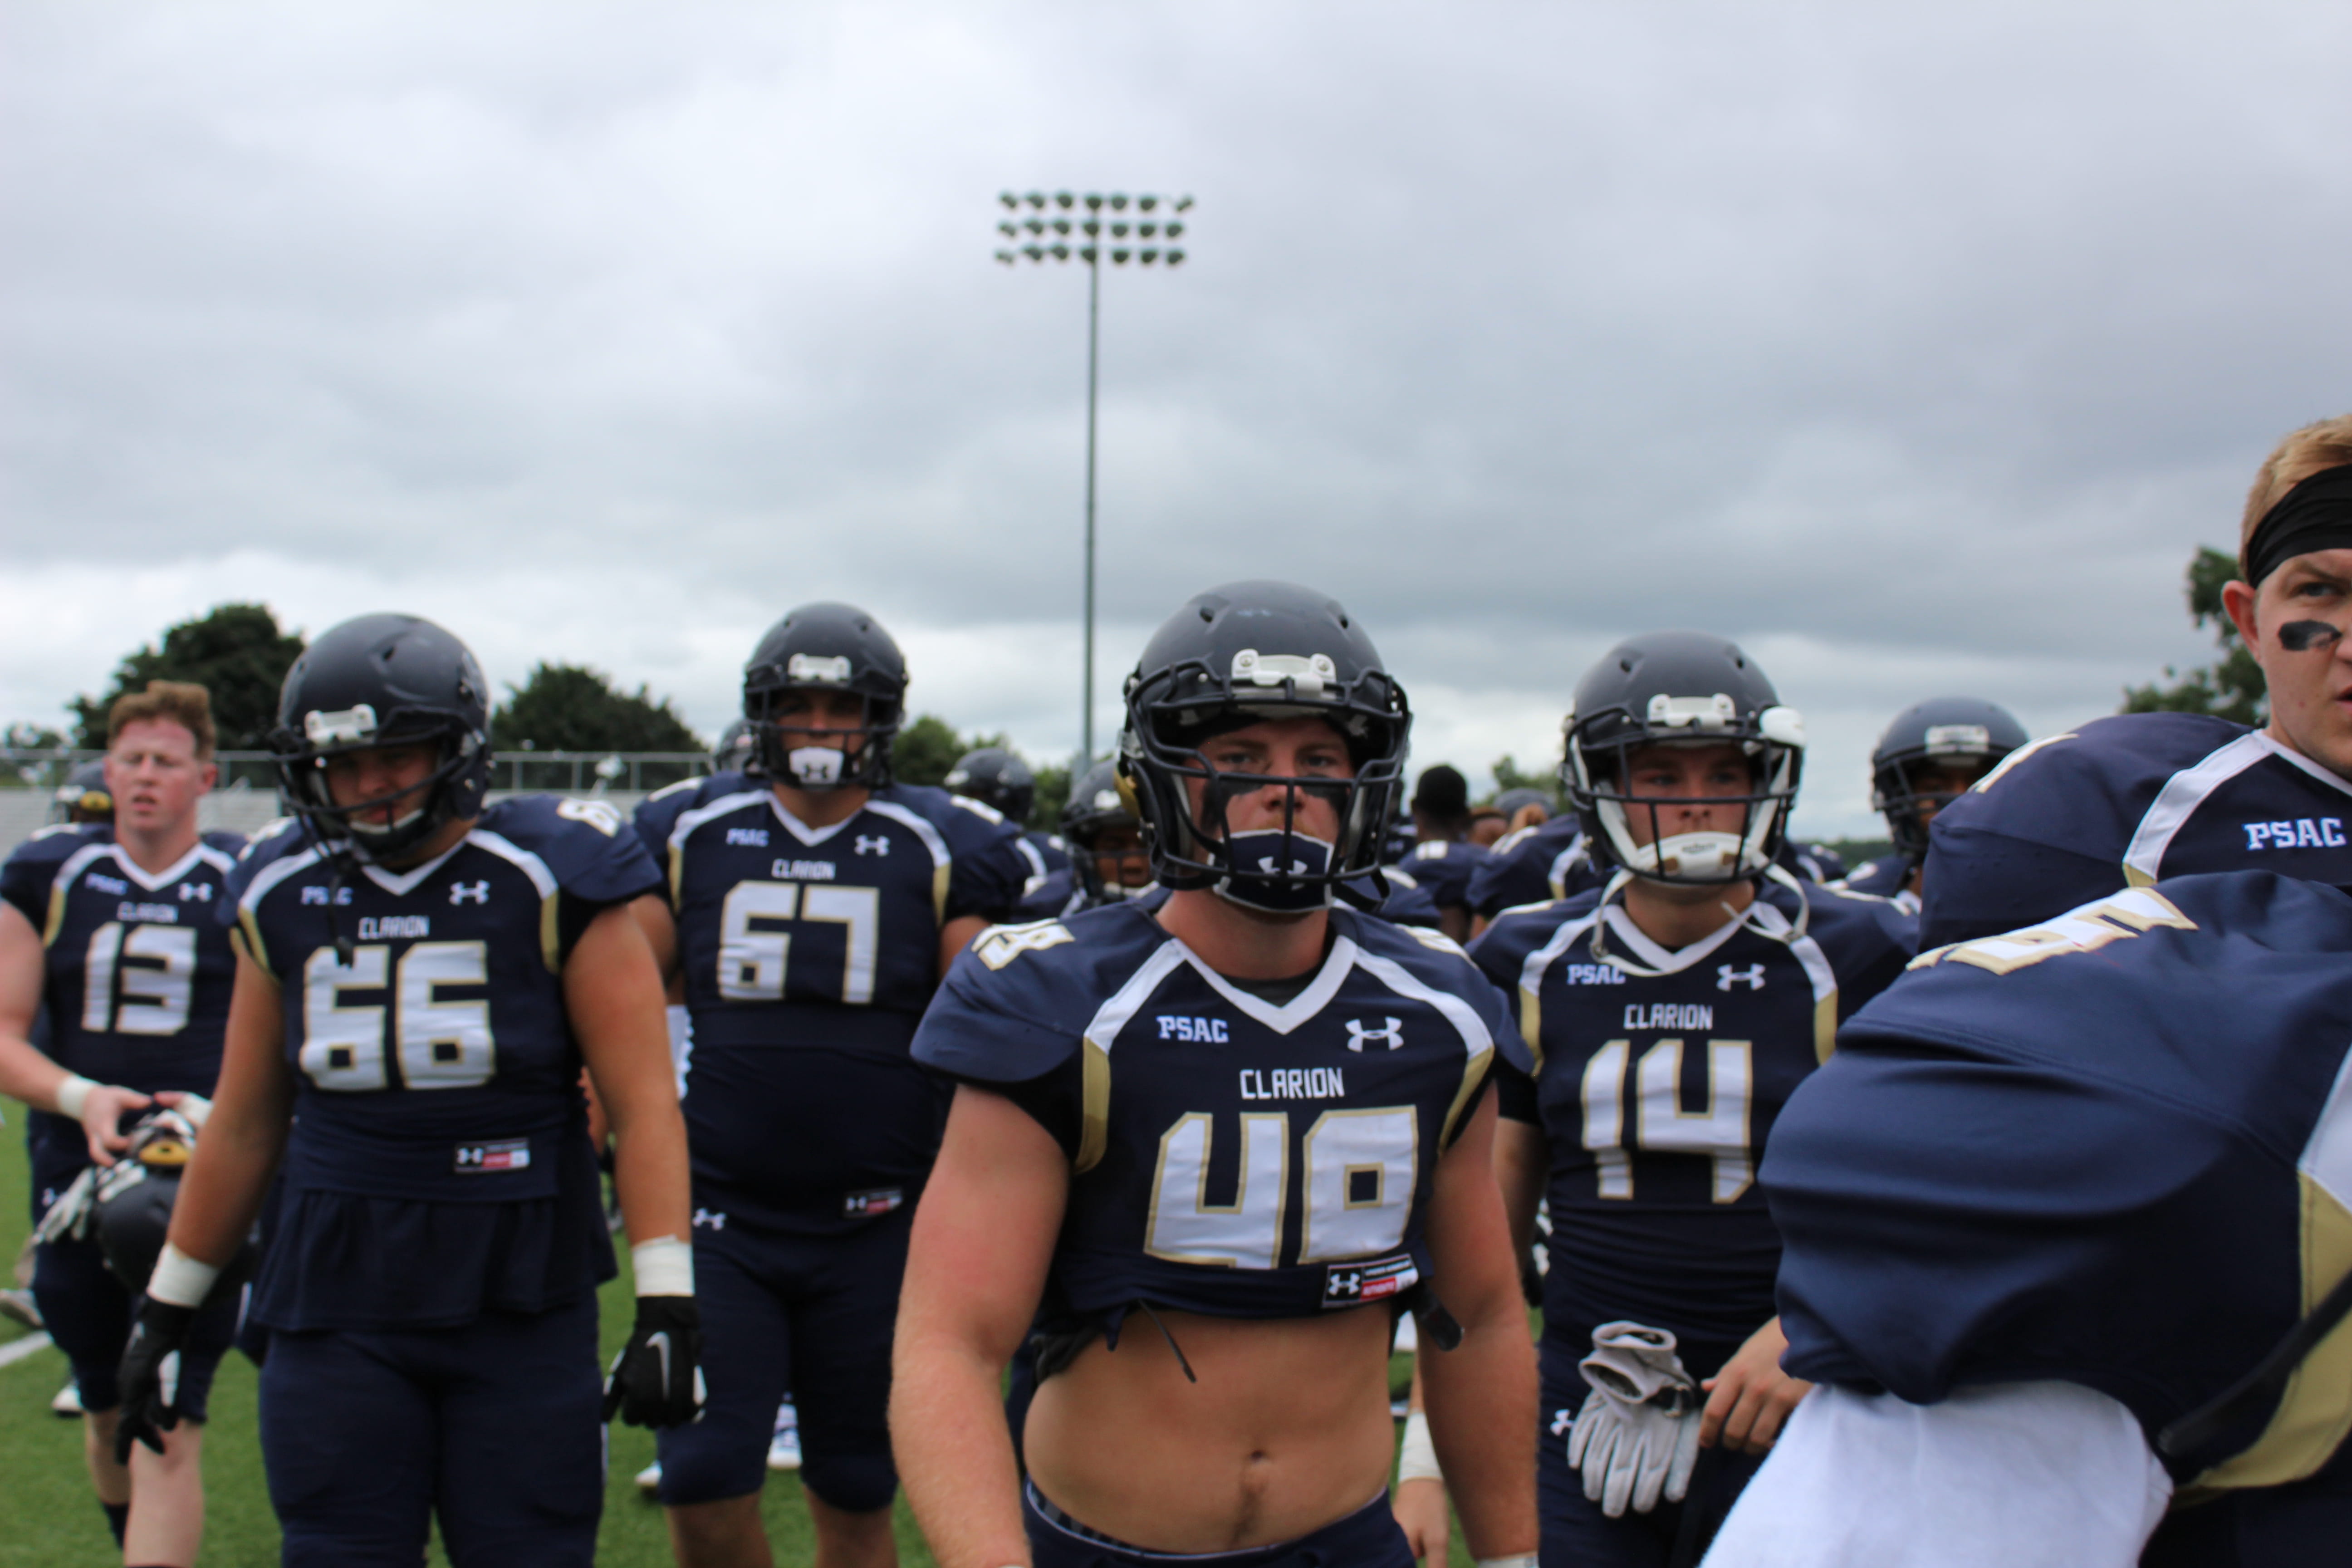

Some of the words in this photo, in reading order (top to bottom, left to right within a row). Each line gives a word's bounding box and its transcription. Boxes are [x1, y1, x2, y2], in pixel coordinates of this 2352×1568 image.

[726, 828, 769, 847] PSAC
[2243, 817, 2347, 850] PSAC
[771, 858, 836, 880] CLARION
[300, 886, 353, 905] PSC
[117, 902, 178, 923] CLARION
[358, 915, 429, 939] CLARION
[718, 880, 879, 1004] 67
[81, 922, 197, 1036] 13
[1568, 964, 1626, 985] PSAC
[299, 941, 495, 1090] 66
[1156, 1015, 1229, 1043] PSAC
[1624, 1004, 1713, 1030] CLARION
[1240, 1068, 1344, 1099] CLARION
[1580, 1039, 1754, 1204] 14
